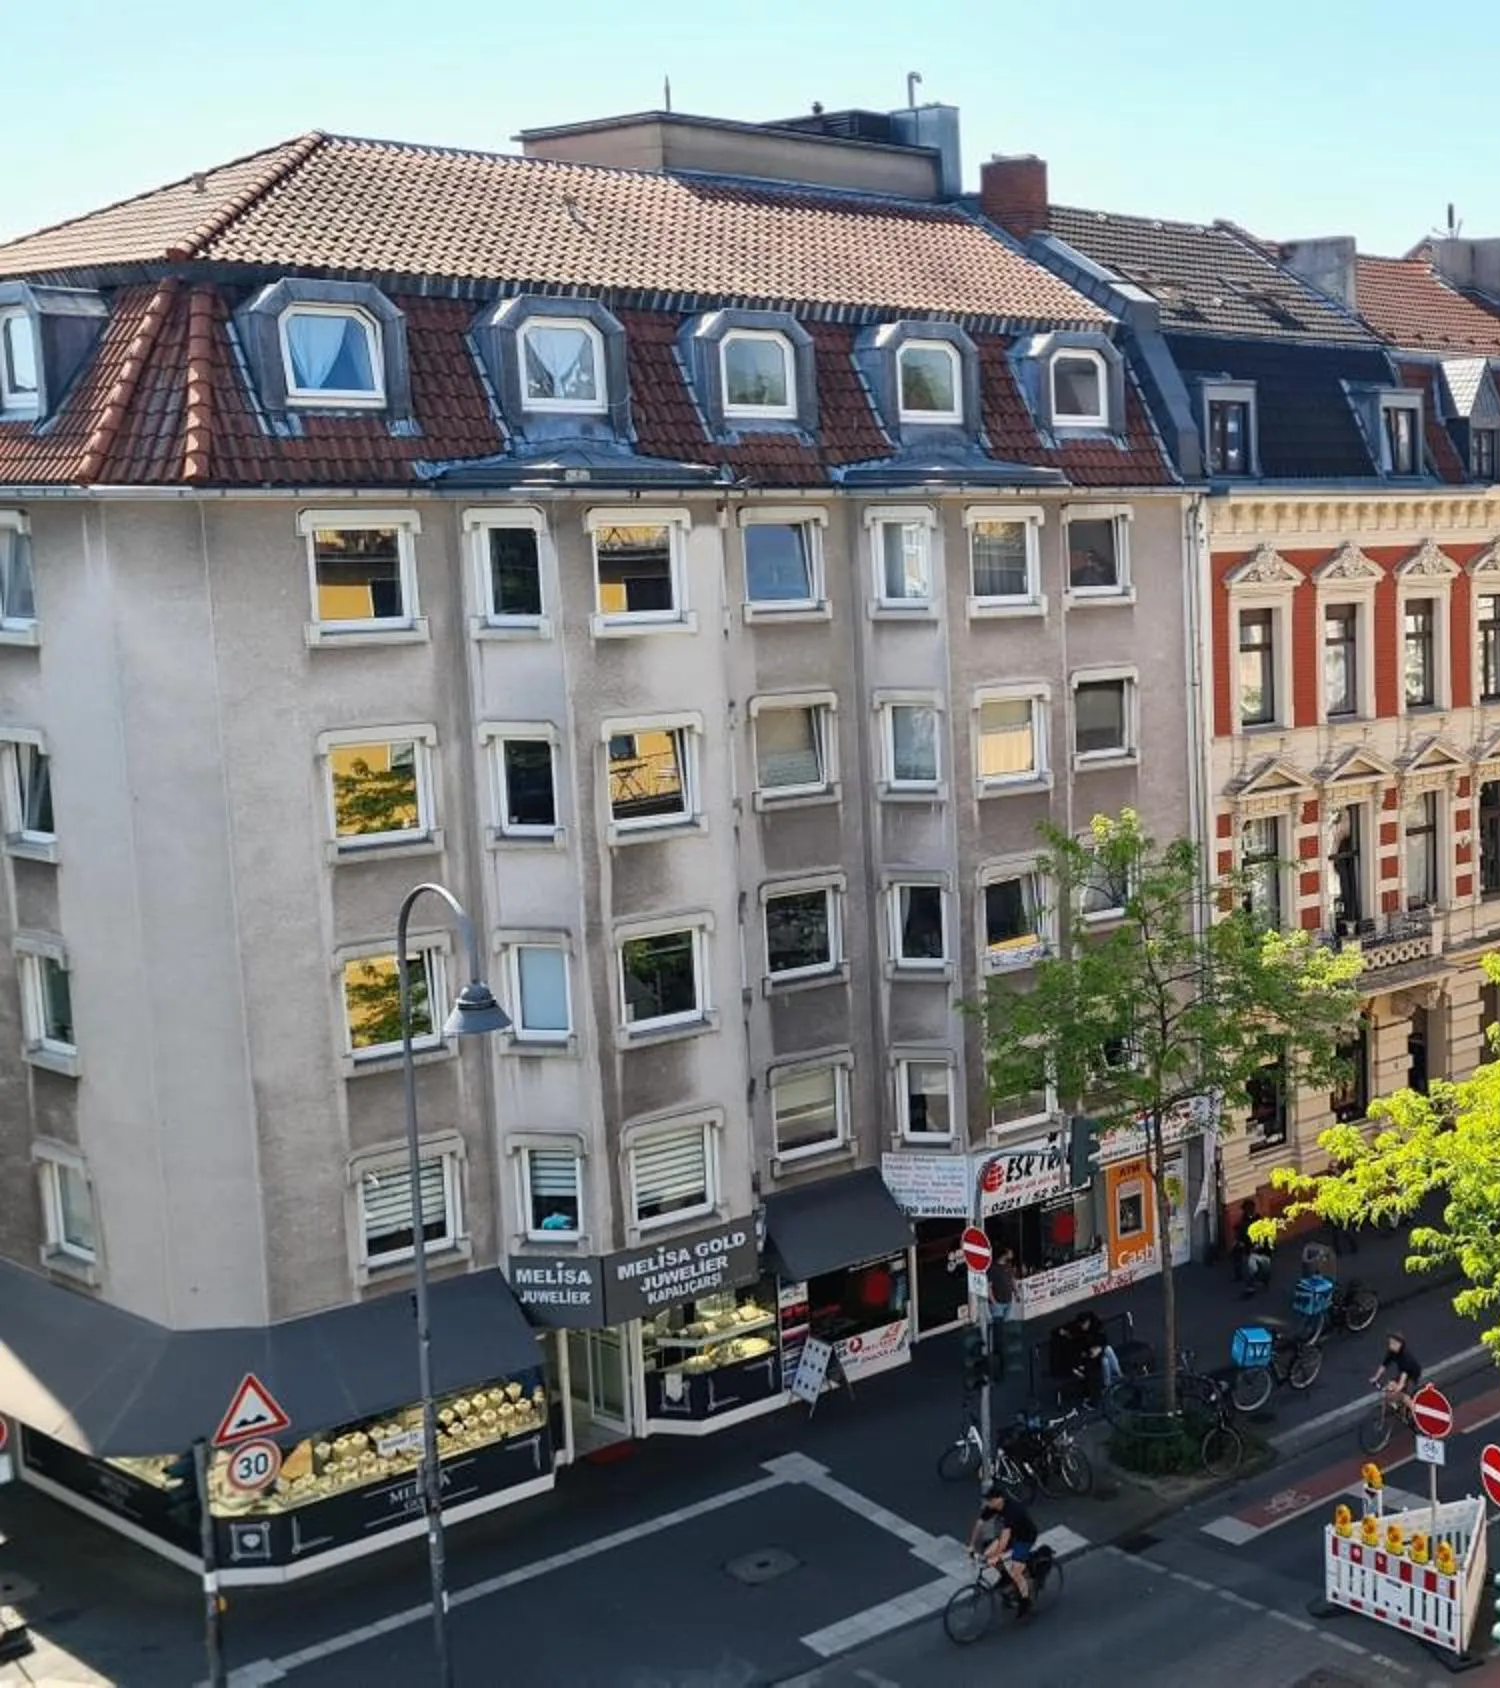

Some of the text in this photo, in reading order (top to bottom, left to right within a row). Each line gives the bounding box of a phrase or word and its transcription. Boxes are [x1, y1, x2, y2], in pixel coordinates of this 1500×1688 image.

[695, 1231, 747, 1257] GOLD
[1117, 1242, 1157, 1268] Cash
[238, 1452, 269, 1480] 30
